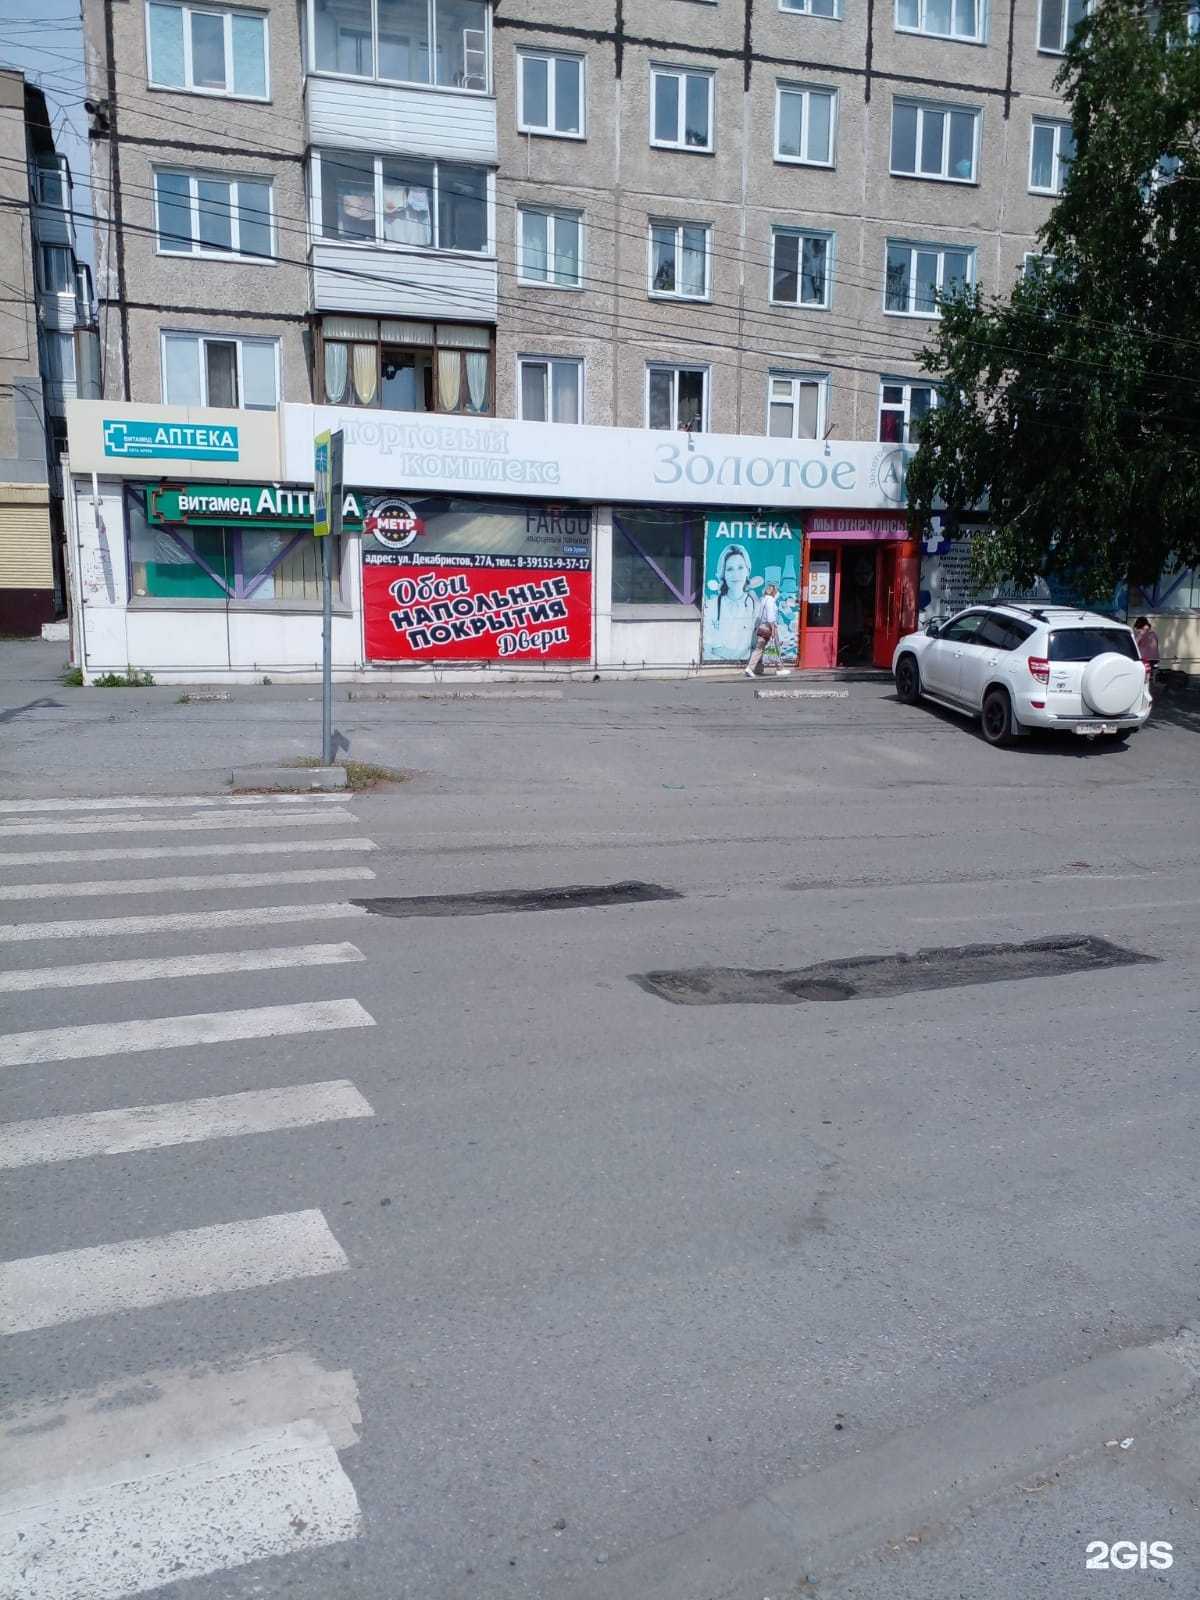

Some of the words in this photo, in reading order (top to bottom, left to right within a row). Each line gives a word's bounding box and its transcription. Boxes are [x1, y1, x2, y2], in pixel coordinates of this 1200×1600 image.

[155, 427, 234, 447] АПТЕКА
[401, 452, 561, 485] комплекс
[653, 443, 857, 490] Золотое
[178, 495, 252, 516] витамед
[255, 488, 360, 517] АПТА
[377, 518, 416, 530] МЕТР
[715, 520, 793, 540] АПТЕКА
[813, 518, 834, 531] МЫ
[364, 553, 396, 566] адрес:
[397, 554, 411, 566] ул.
[412, 553, 473, 568] Декабристов,
[495, 557, 516, 568] тел.:
[517, 556, 590, 570] 8-39151-9-37-17
[390, 573, 469, 605] Обои
[811, 584, 827, 595] 22
[390, 576, 569, 632] НАПОЛЬНЫЕ
[407, 598, 568, 650] ПОКРЫТИЯ
[497, 626, 569, 656] Двери
